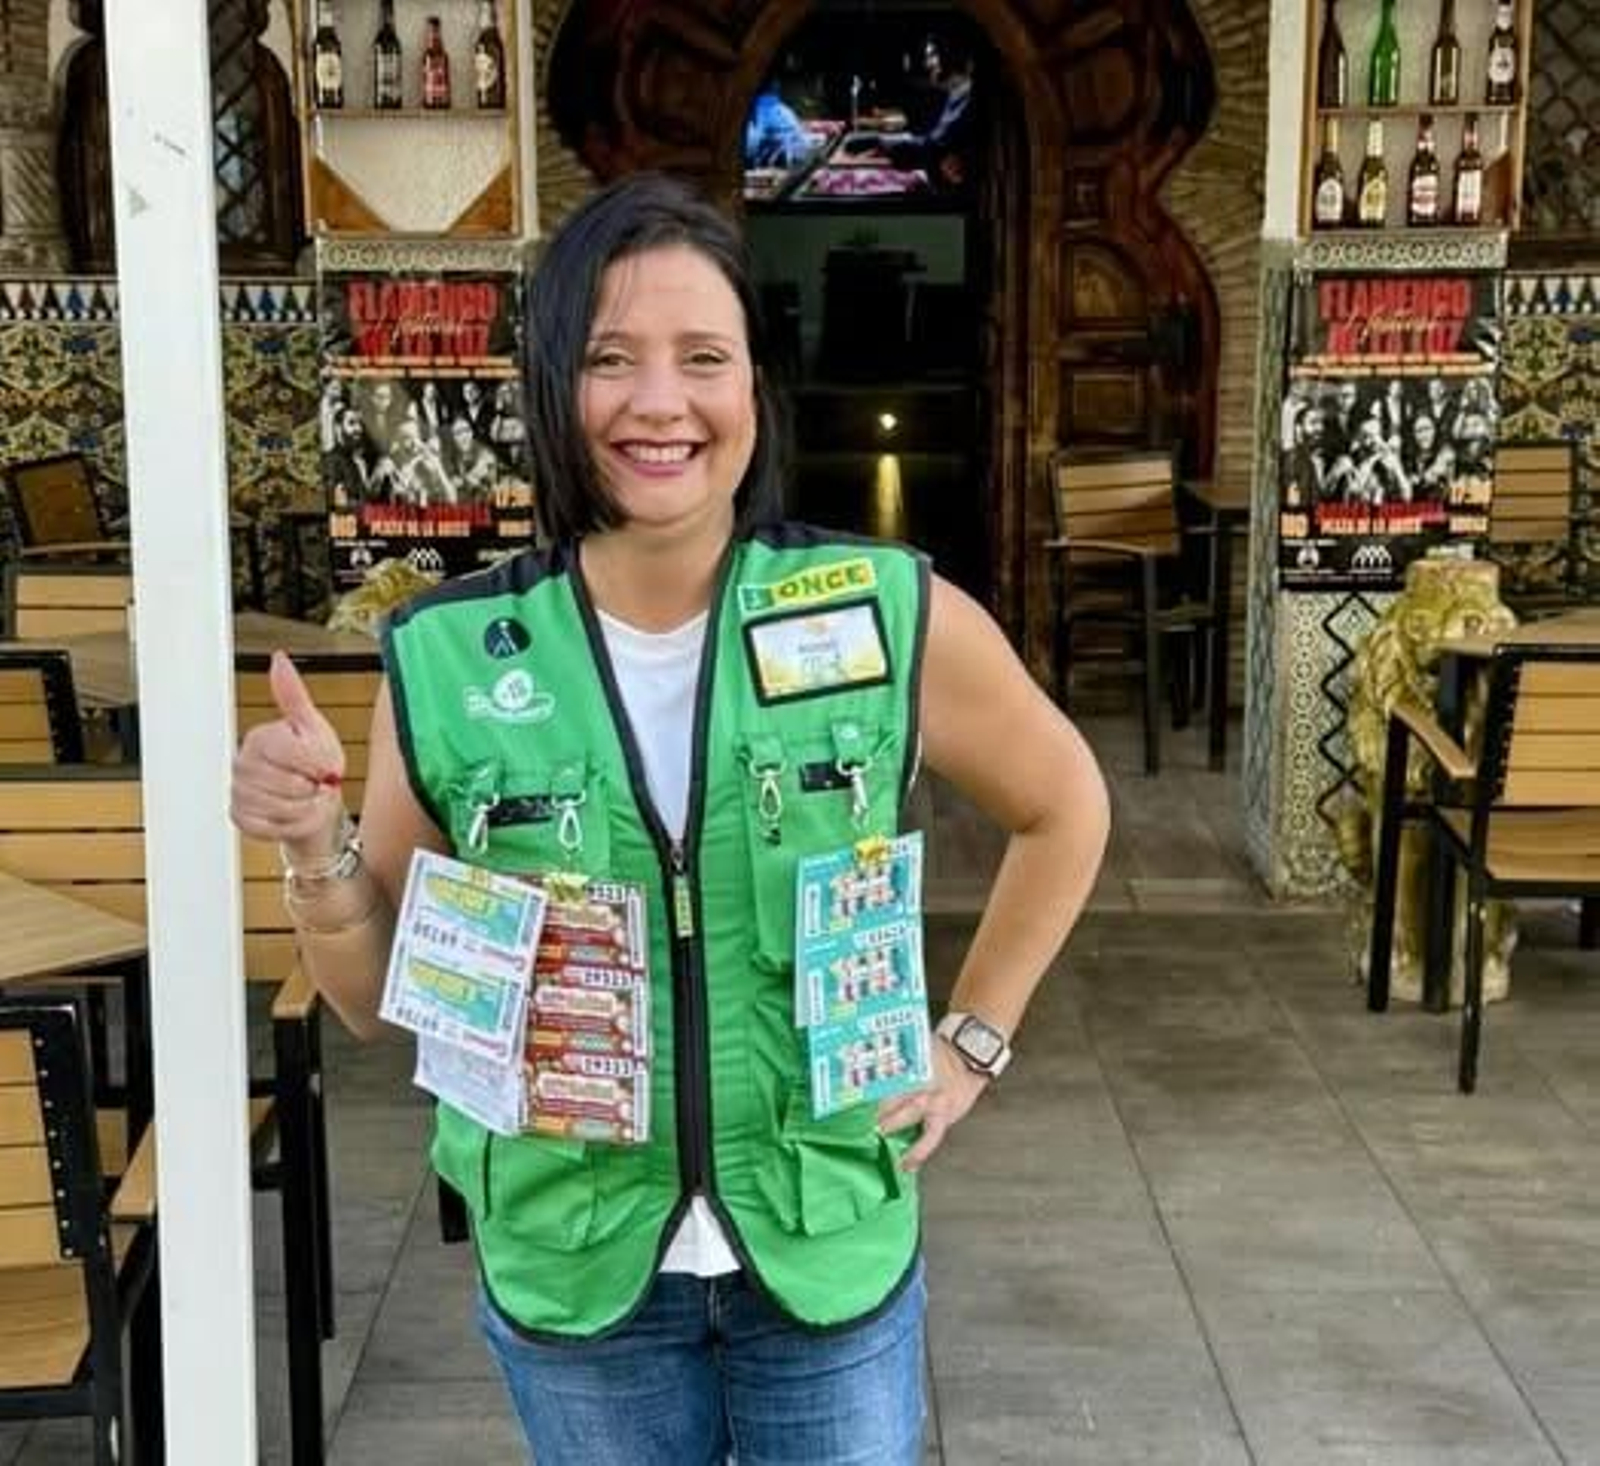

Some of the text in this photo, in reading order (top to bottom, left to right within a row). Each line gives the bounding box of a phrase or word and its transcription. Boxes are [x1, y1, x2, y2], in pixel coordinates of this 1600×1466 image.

[348, 281, 498, 321] FLAMENCO
[1318, 279, 1471, 319] FLAMENCO
[779, 563, 870, 598] ONCE
